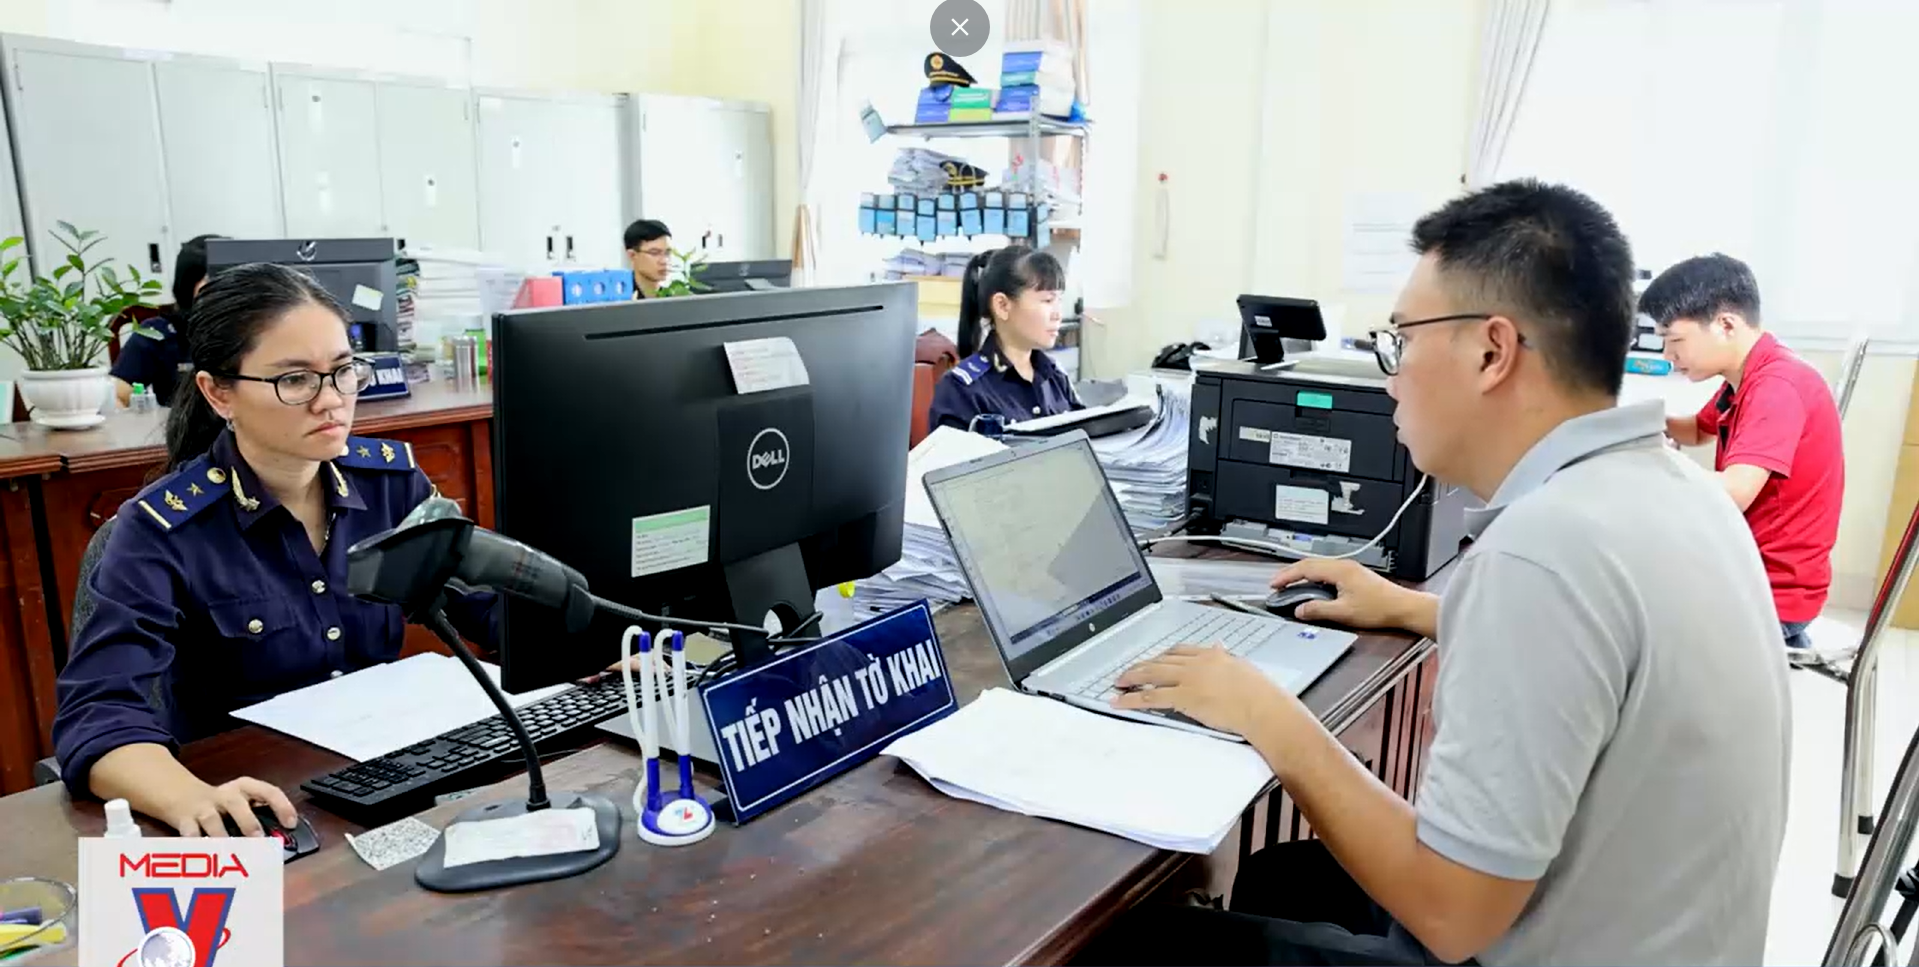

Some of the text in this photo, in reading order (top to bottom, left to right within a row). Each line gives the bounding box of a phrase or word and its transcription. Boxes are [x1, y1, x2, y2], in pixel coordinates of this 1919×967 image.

[752, 449, 785, 470] DELL
[720, 639, 941, 772] TIẾP NHẬN TỜ KHAI
